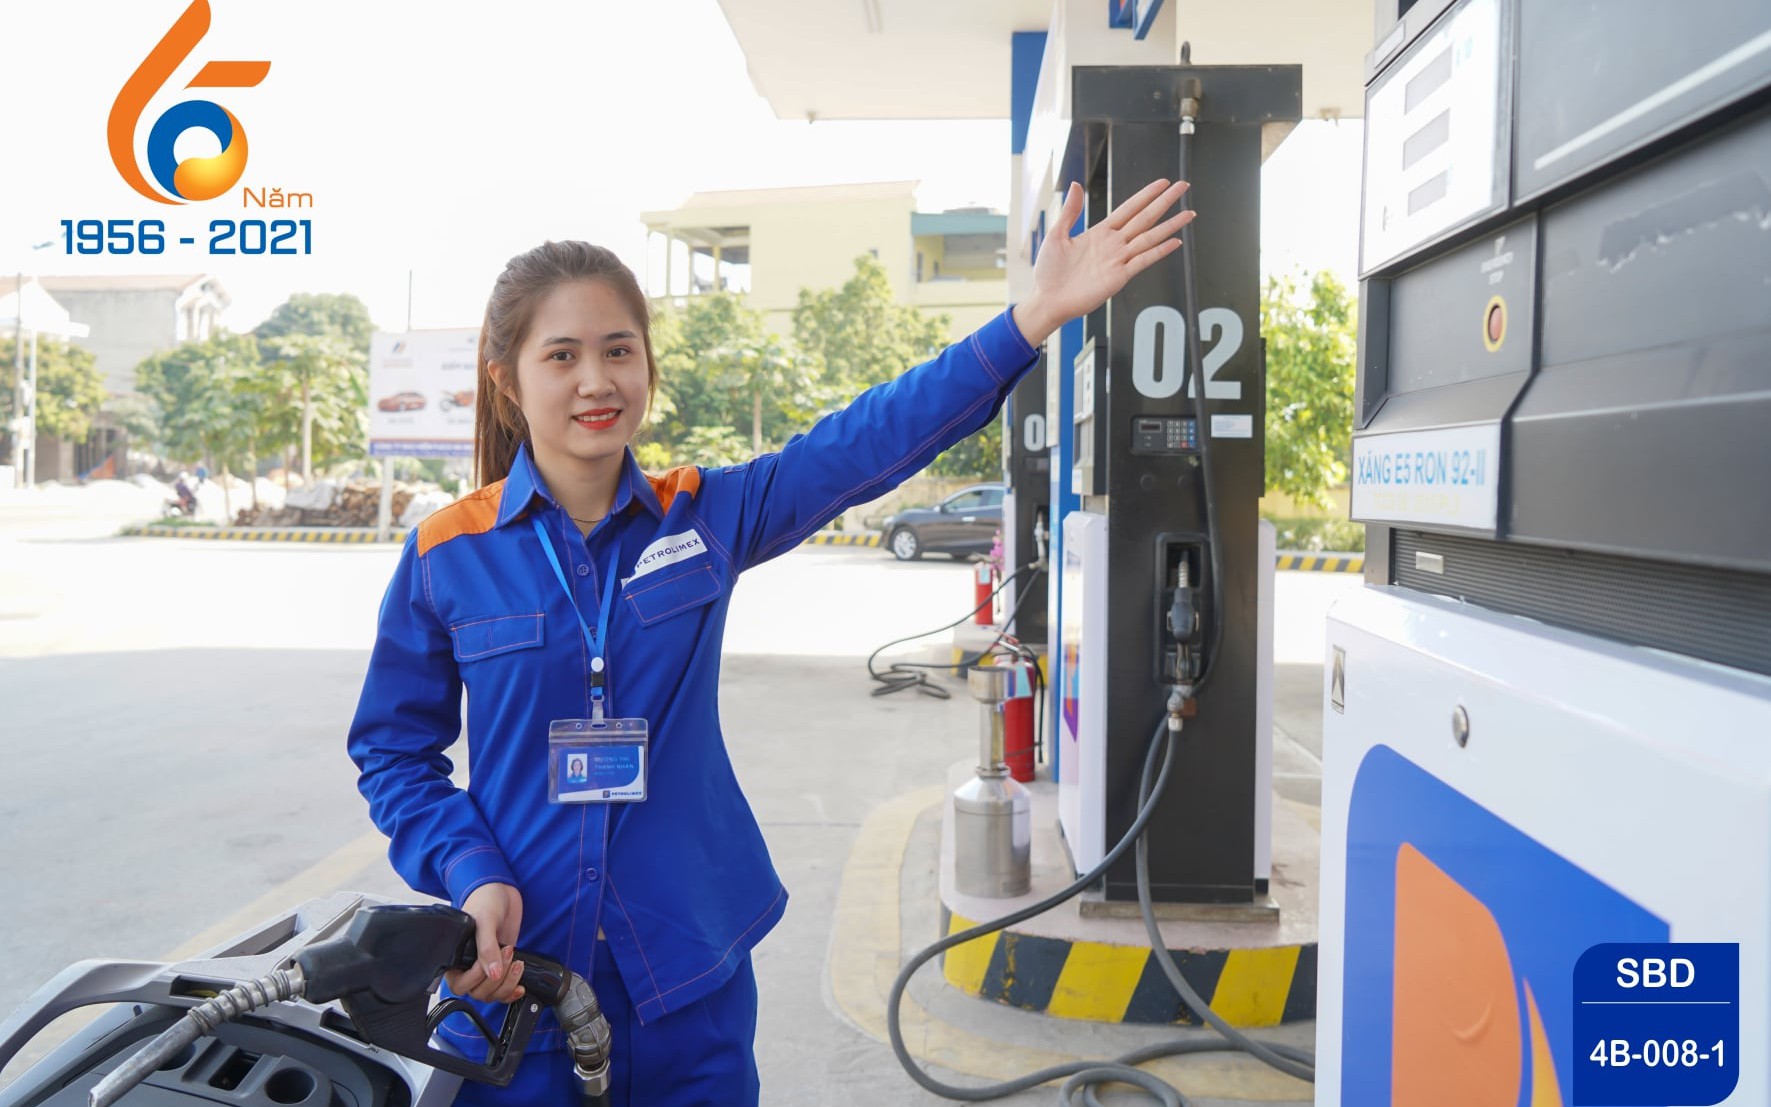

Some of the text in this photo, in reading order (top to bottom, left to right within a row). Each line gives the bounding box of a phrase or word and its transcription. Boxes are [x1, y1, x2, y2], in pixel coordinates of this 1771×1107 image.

[1132, 305, 1244, 400] 02
[1023, 413, 1046, 452] 0
[1357, 450, 1391, 485] XĂNG
[1395, 452, 1411, 485] E5
[1414, 451, 1447, 485] RON
